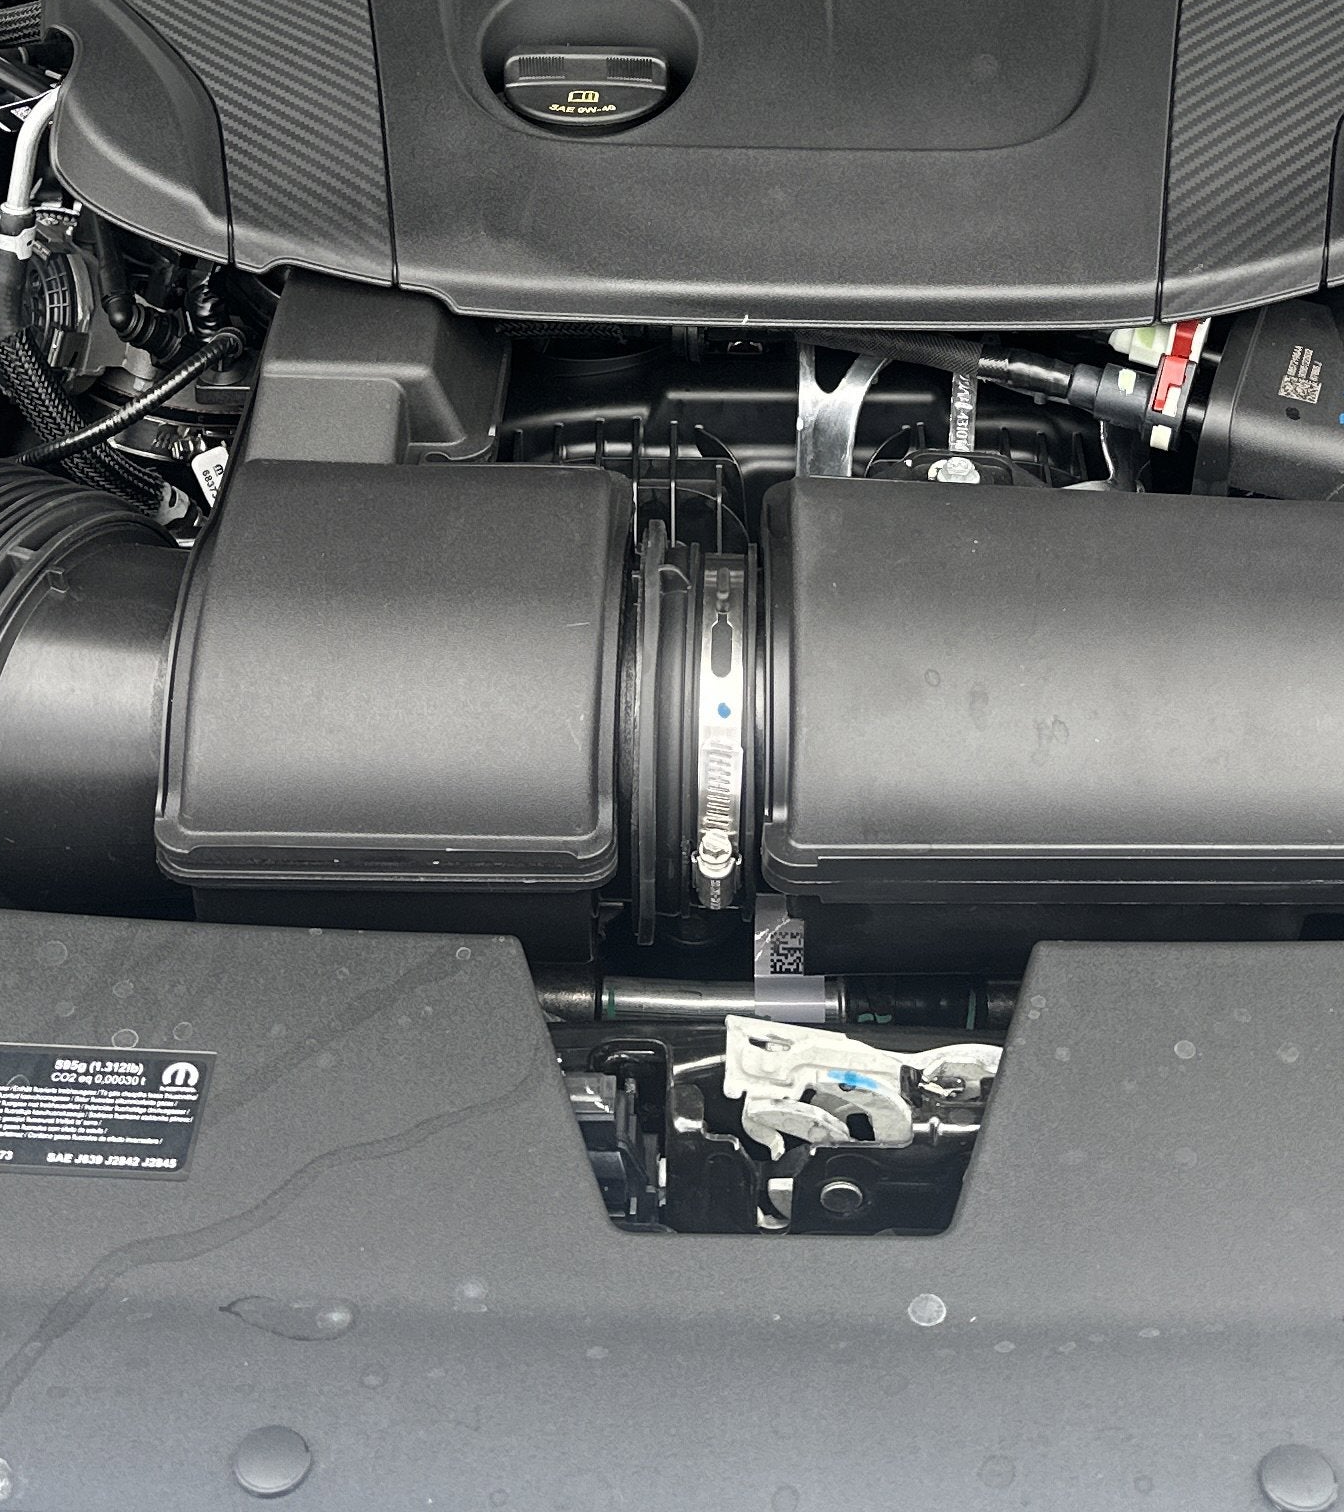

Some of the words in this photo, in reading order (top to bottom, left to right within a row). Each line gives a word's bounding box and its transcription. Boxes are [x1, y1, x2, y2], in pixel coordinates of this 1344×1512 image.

[548, 103, 576, 113] SAE
[54, 1059, 87, 1073] 595g
[50, 1073, 76, 1083] CO2
[46, 1152, 73, 1164] SAE
